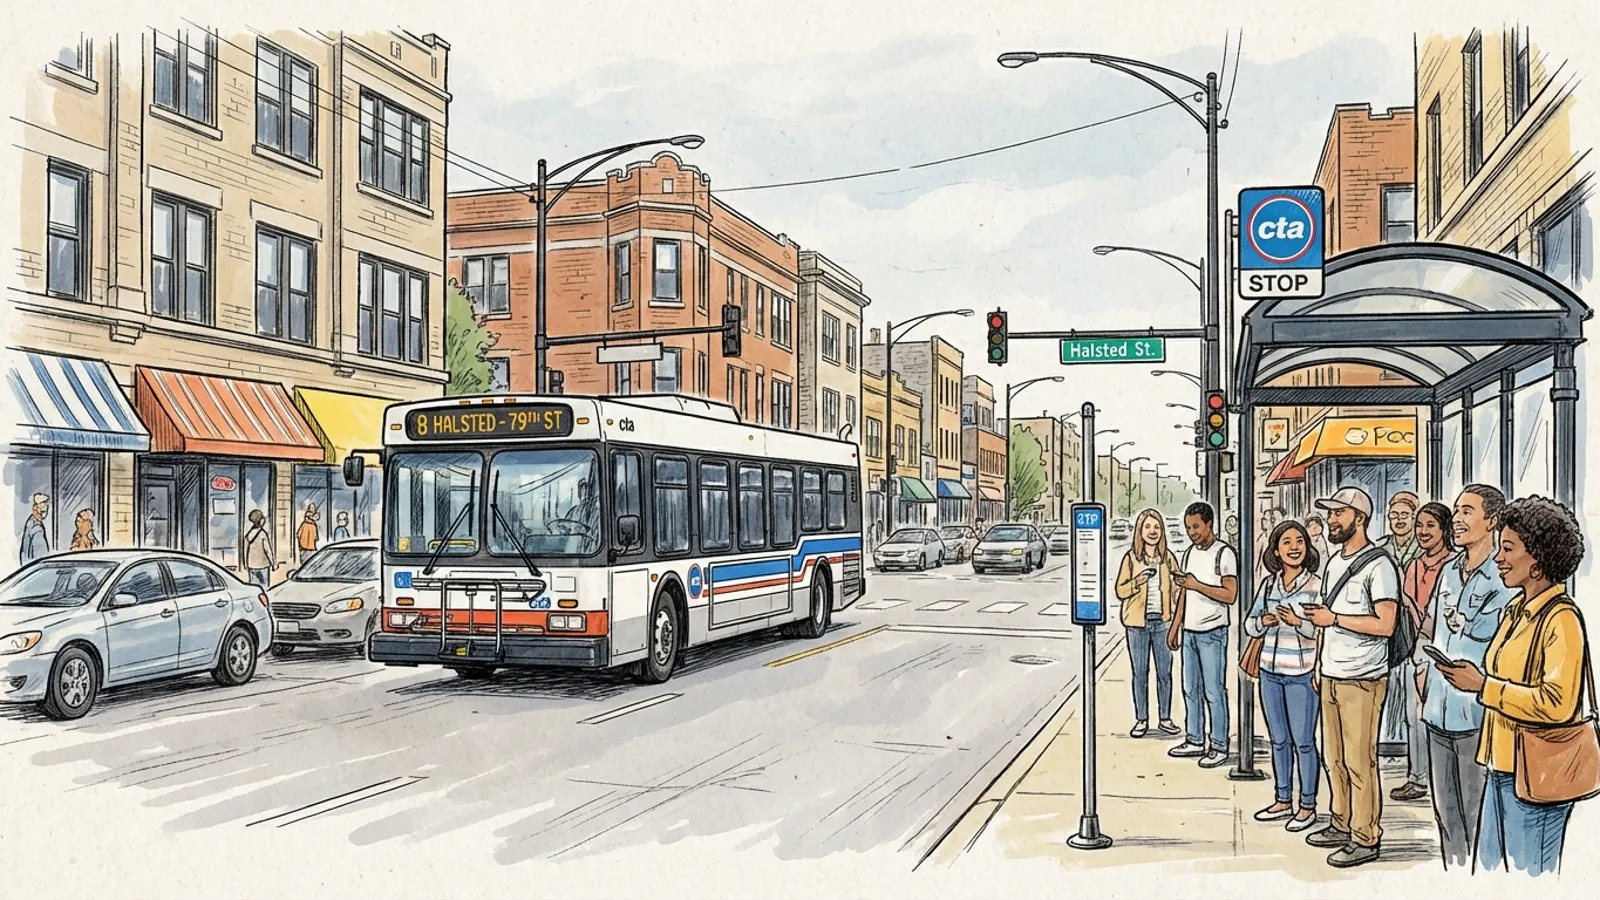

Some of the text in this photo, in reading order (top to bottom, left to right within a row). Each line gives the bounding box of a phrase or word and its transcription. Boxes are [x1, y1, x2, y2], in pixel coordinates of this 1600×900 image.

[1258, 216, 1305, 239] cta
[1249, 274, 1308, 292] STOP
[1070, 341, 1155, 358] Halsted St.
[417, 414, 428, 436] 8
[433, 413, 496, 434] HALSTED
[544, 410, 563, 430] ST
